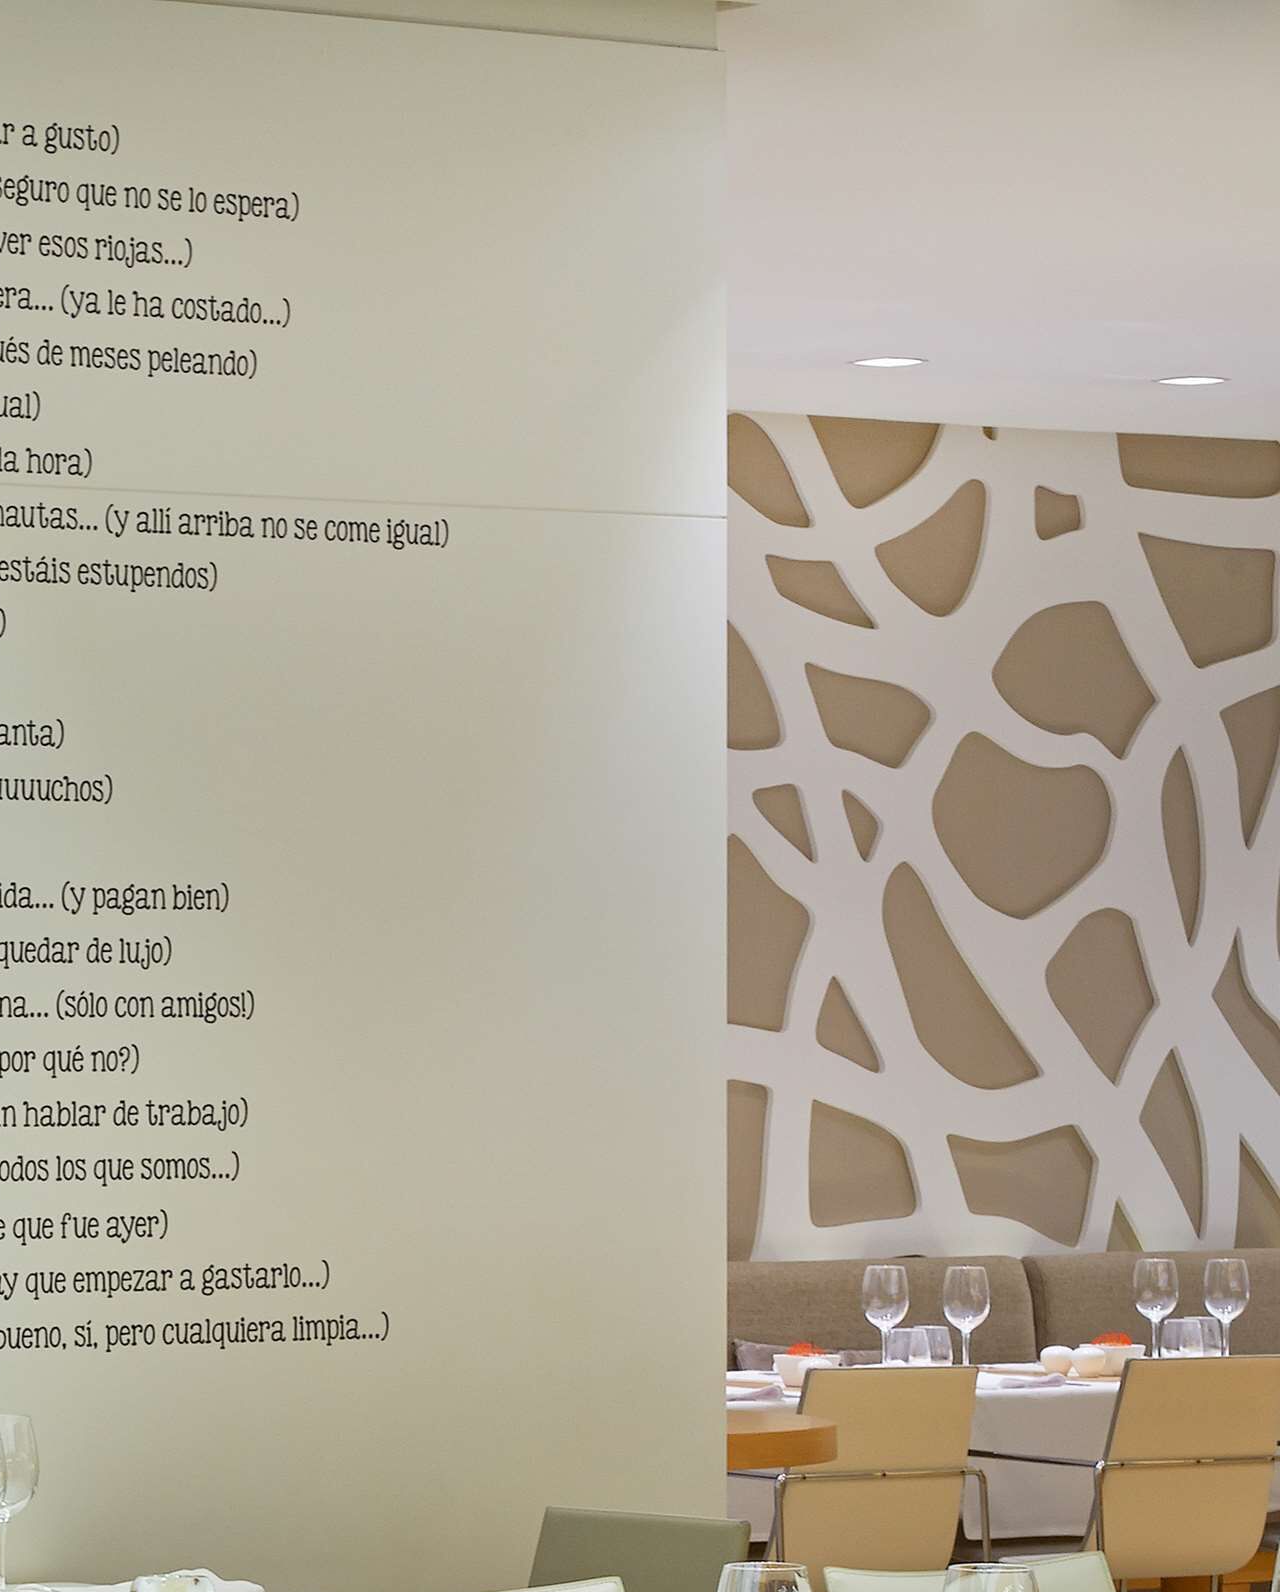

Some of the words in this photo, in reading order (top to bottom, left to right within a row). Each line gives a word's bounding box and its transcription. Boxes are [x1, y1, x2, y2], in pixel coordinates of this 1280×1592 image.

[21, 124, 39, 148] a
[43, 122, 120, 156] gusto)
[38, 234, 89, 260] esos
[94, 234, 193, 269] riojas...)
[36, 338, 64, 367] de
[69, 345, 142, 371] meses
[147, 347, 258, 380] peleando)
[104, 503, 131, 539] (y
[136, 506, 172, 535] allí
[177, 510, 255, 539] arriba
[260, 516, 288, 539] no
[293, 517, 318, 541] se
[324, 519, 381, 544] come
[386, 518, 449, 551] igual)
[85, 936, 113, 964] de
[118, 935, 173, 971] lujo)
[42, 1044, 85, 1079] qué
[90, 1043, 140, 1075] no?)
[55, 1155, 87, 1182] los
[93, 1157, 135, 1188] que
[140, 1150, 240, 1182] somos...)
[73, 1319, 98, 1350] sí,
[105, 1323, 156, 1353] pero
[162, 1316, 287, 1350] cualquiera
[291, 1311, 390, 1347] limpia...)
